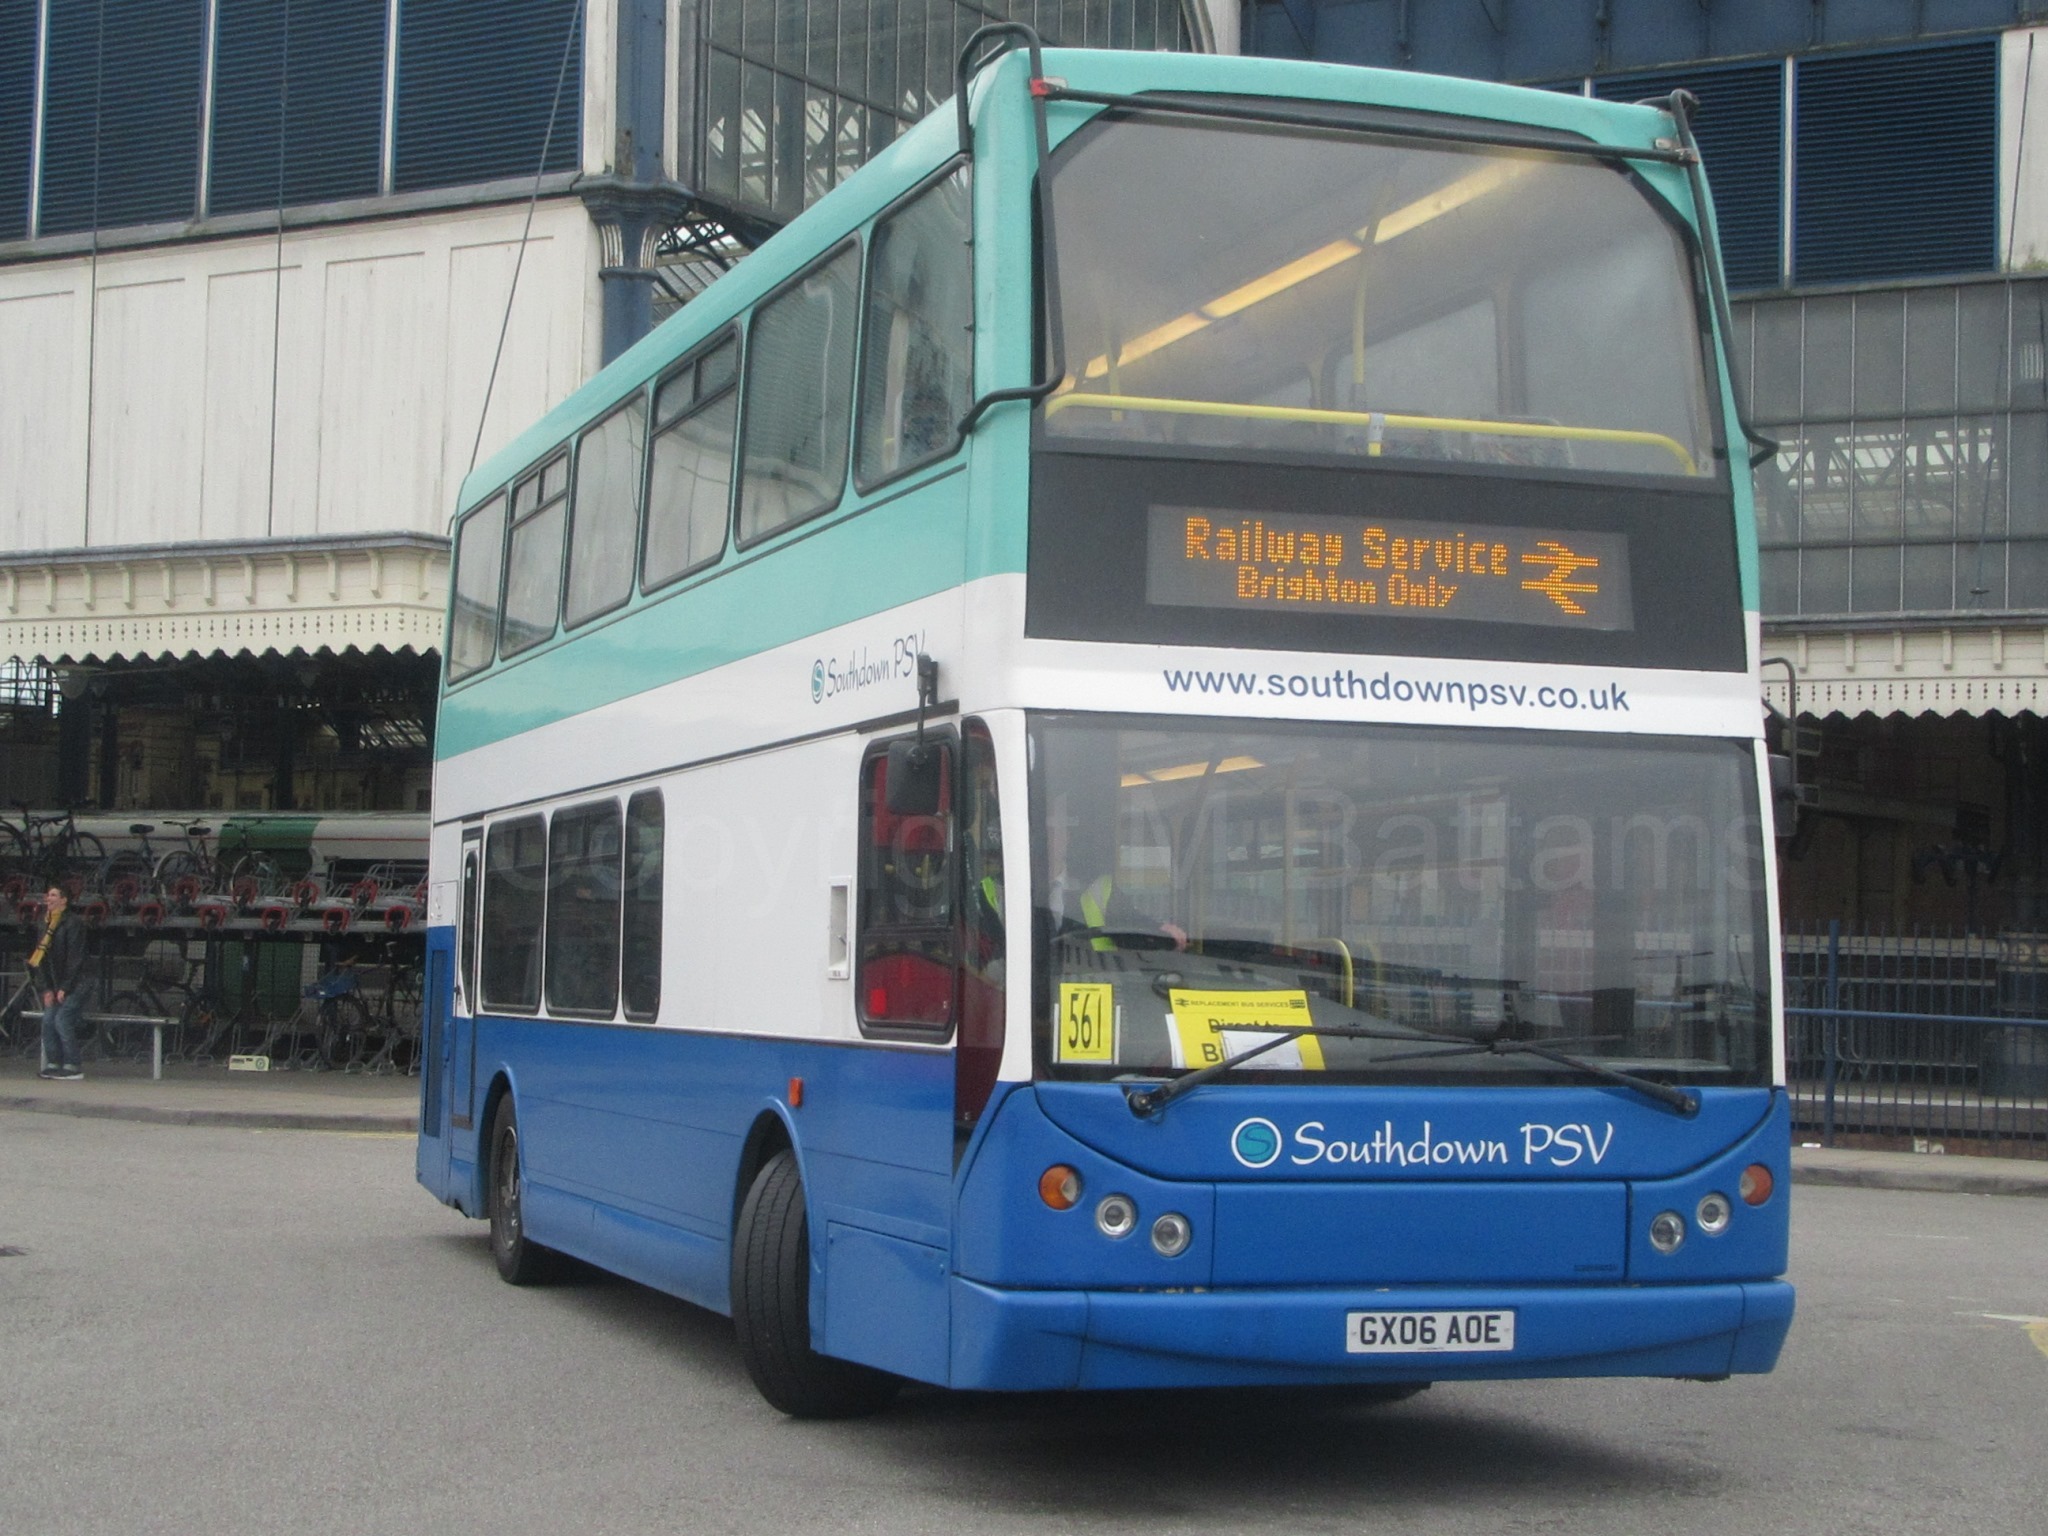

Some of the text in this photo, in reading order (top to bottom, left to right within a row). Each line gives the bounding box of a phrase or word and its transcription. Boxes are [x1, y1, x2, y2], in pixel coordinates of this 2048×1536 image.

[1186, 516, 1509, 576] Railway Service
[1236, 565, 1458, 608] Brighton Only
[826, 629, 926, 698] Southdown PSV
[1162, 668, 1631, 712] www.southdownpsv.co.uk
[1068, 993, 1102, 1049] 561
[1190, 999, 1240, 1008] REPLACEMENT
[1256, 1001, 1290, 1009] SERVICES
[1290, 1120, 1614, 1167] Southdown PSV
[1359, 1314, 1501, 1346] GX06 AOE
